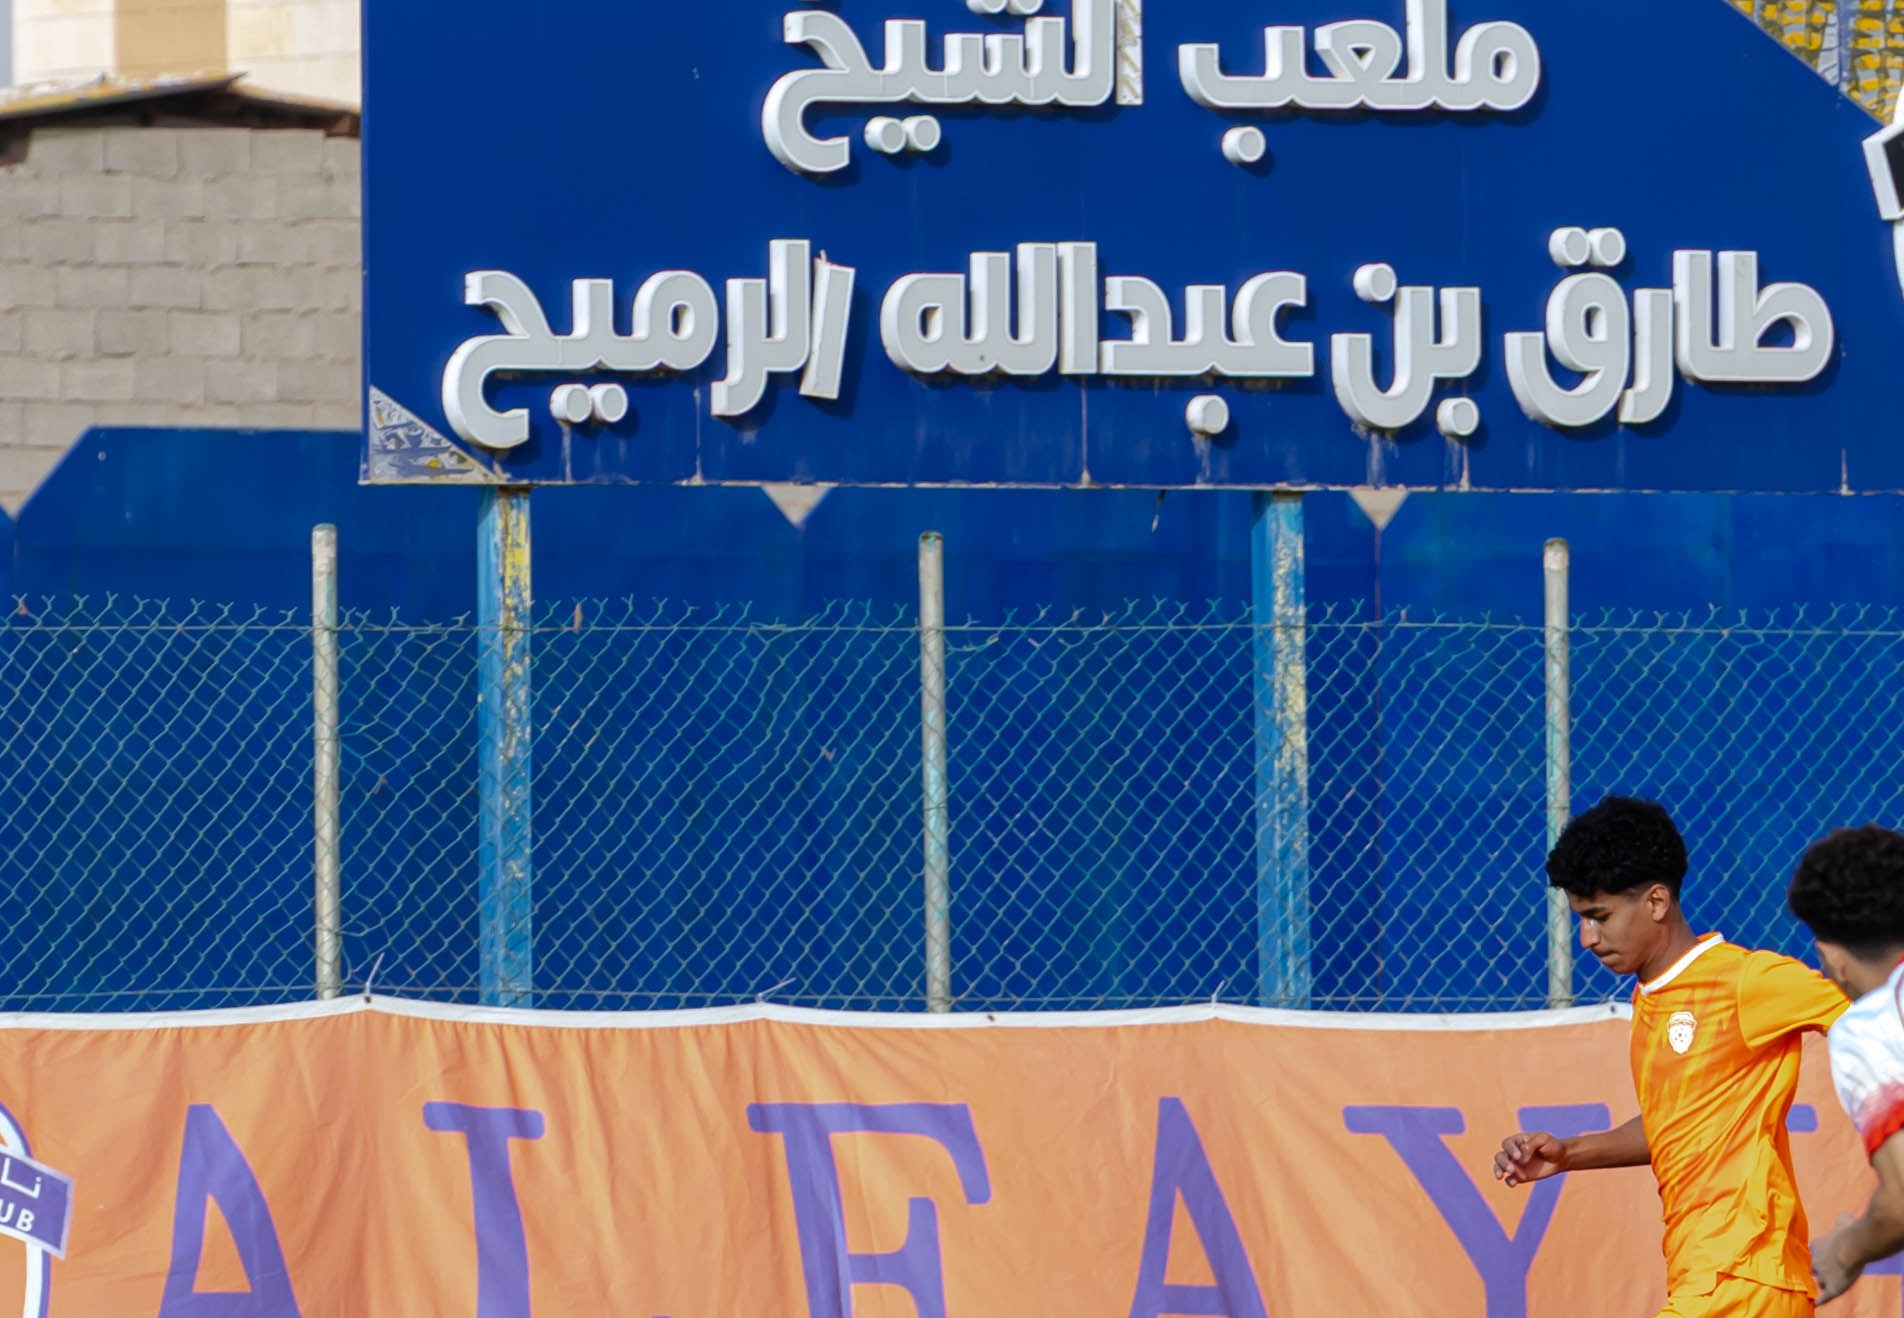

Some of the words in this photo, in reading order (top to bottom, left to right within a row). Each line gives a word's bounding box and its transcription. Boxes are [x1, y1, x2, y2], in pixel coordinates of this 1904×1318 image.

[1178, 0, 1542, 164] ملعب
[441, 239, 856, 449] الرميح
[1330, 263, 1482, 438] بن
[1504, 227, 1835, 426] طارق
[0, 1198, 35, 1232] UB
